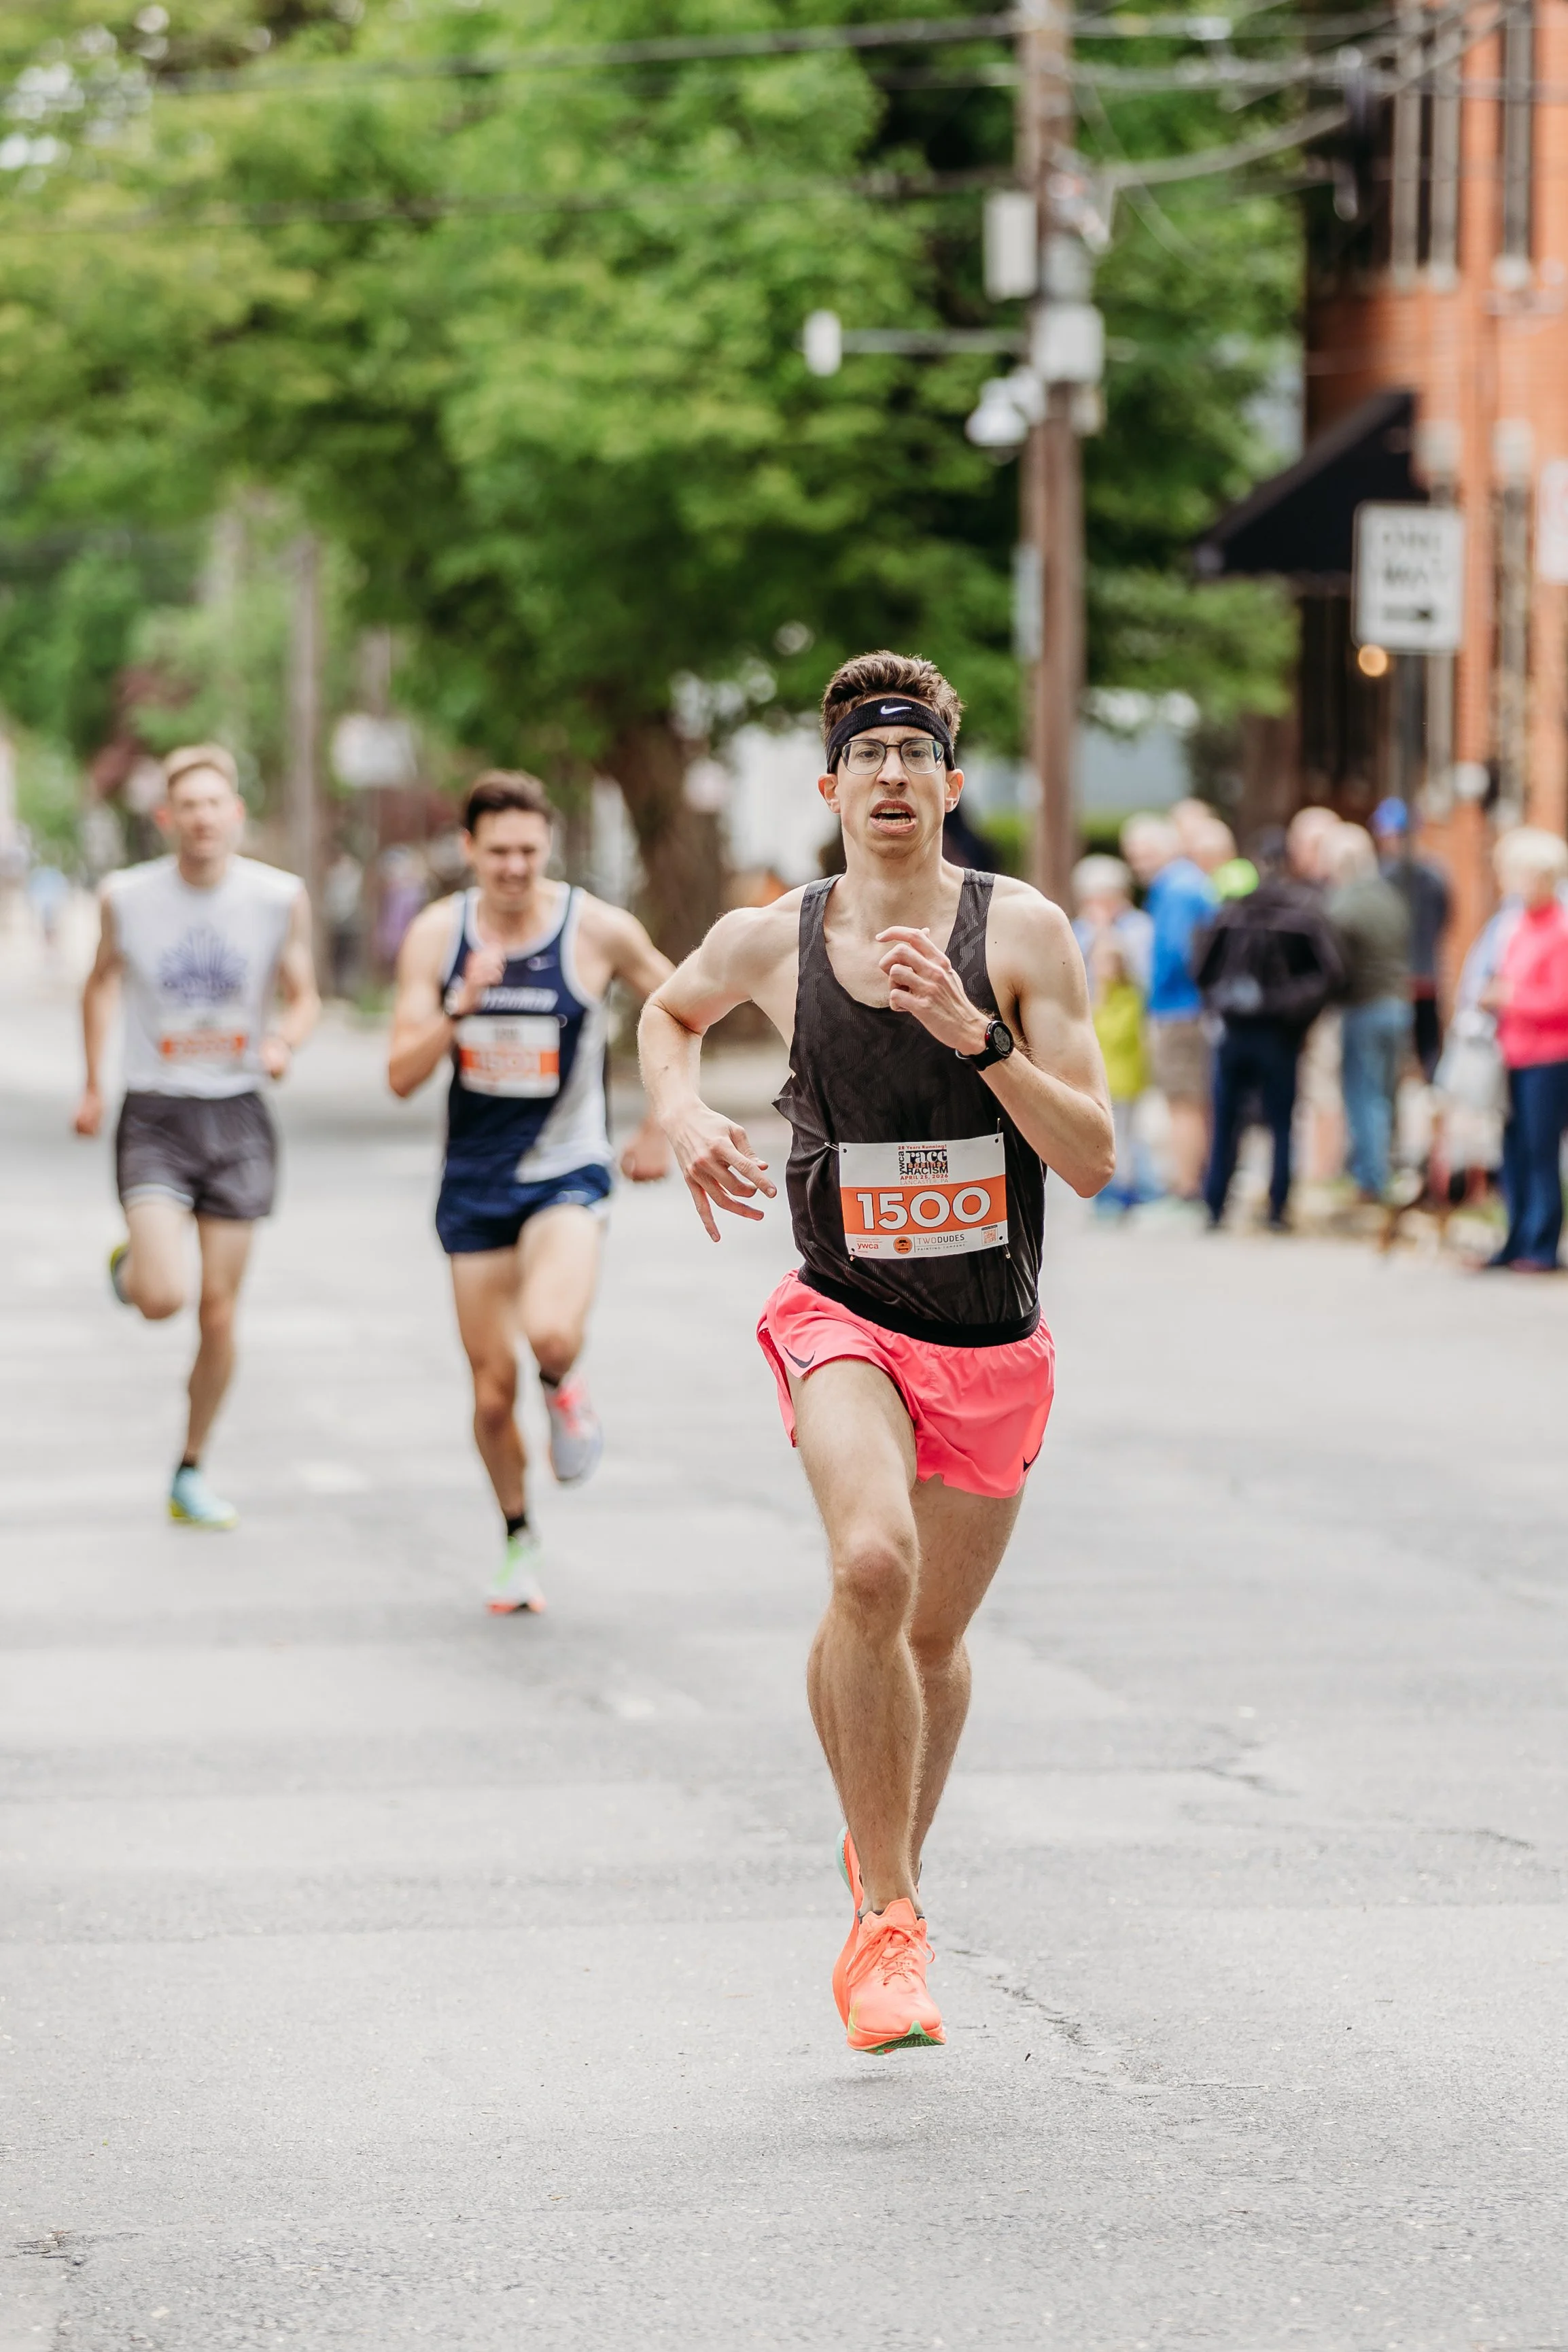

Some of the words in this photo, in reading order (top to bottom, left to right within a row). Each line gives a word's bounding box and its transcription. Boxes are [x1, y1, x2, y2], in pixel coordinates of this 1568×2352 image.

[899, 1151, 907, 1175] ywca
[906, 1150, 947, 1163] race
[907, 1166, 948, 1175] RACISM
[856, 1186, 992, 1230] 1500
